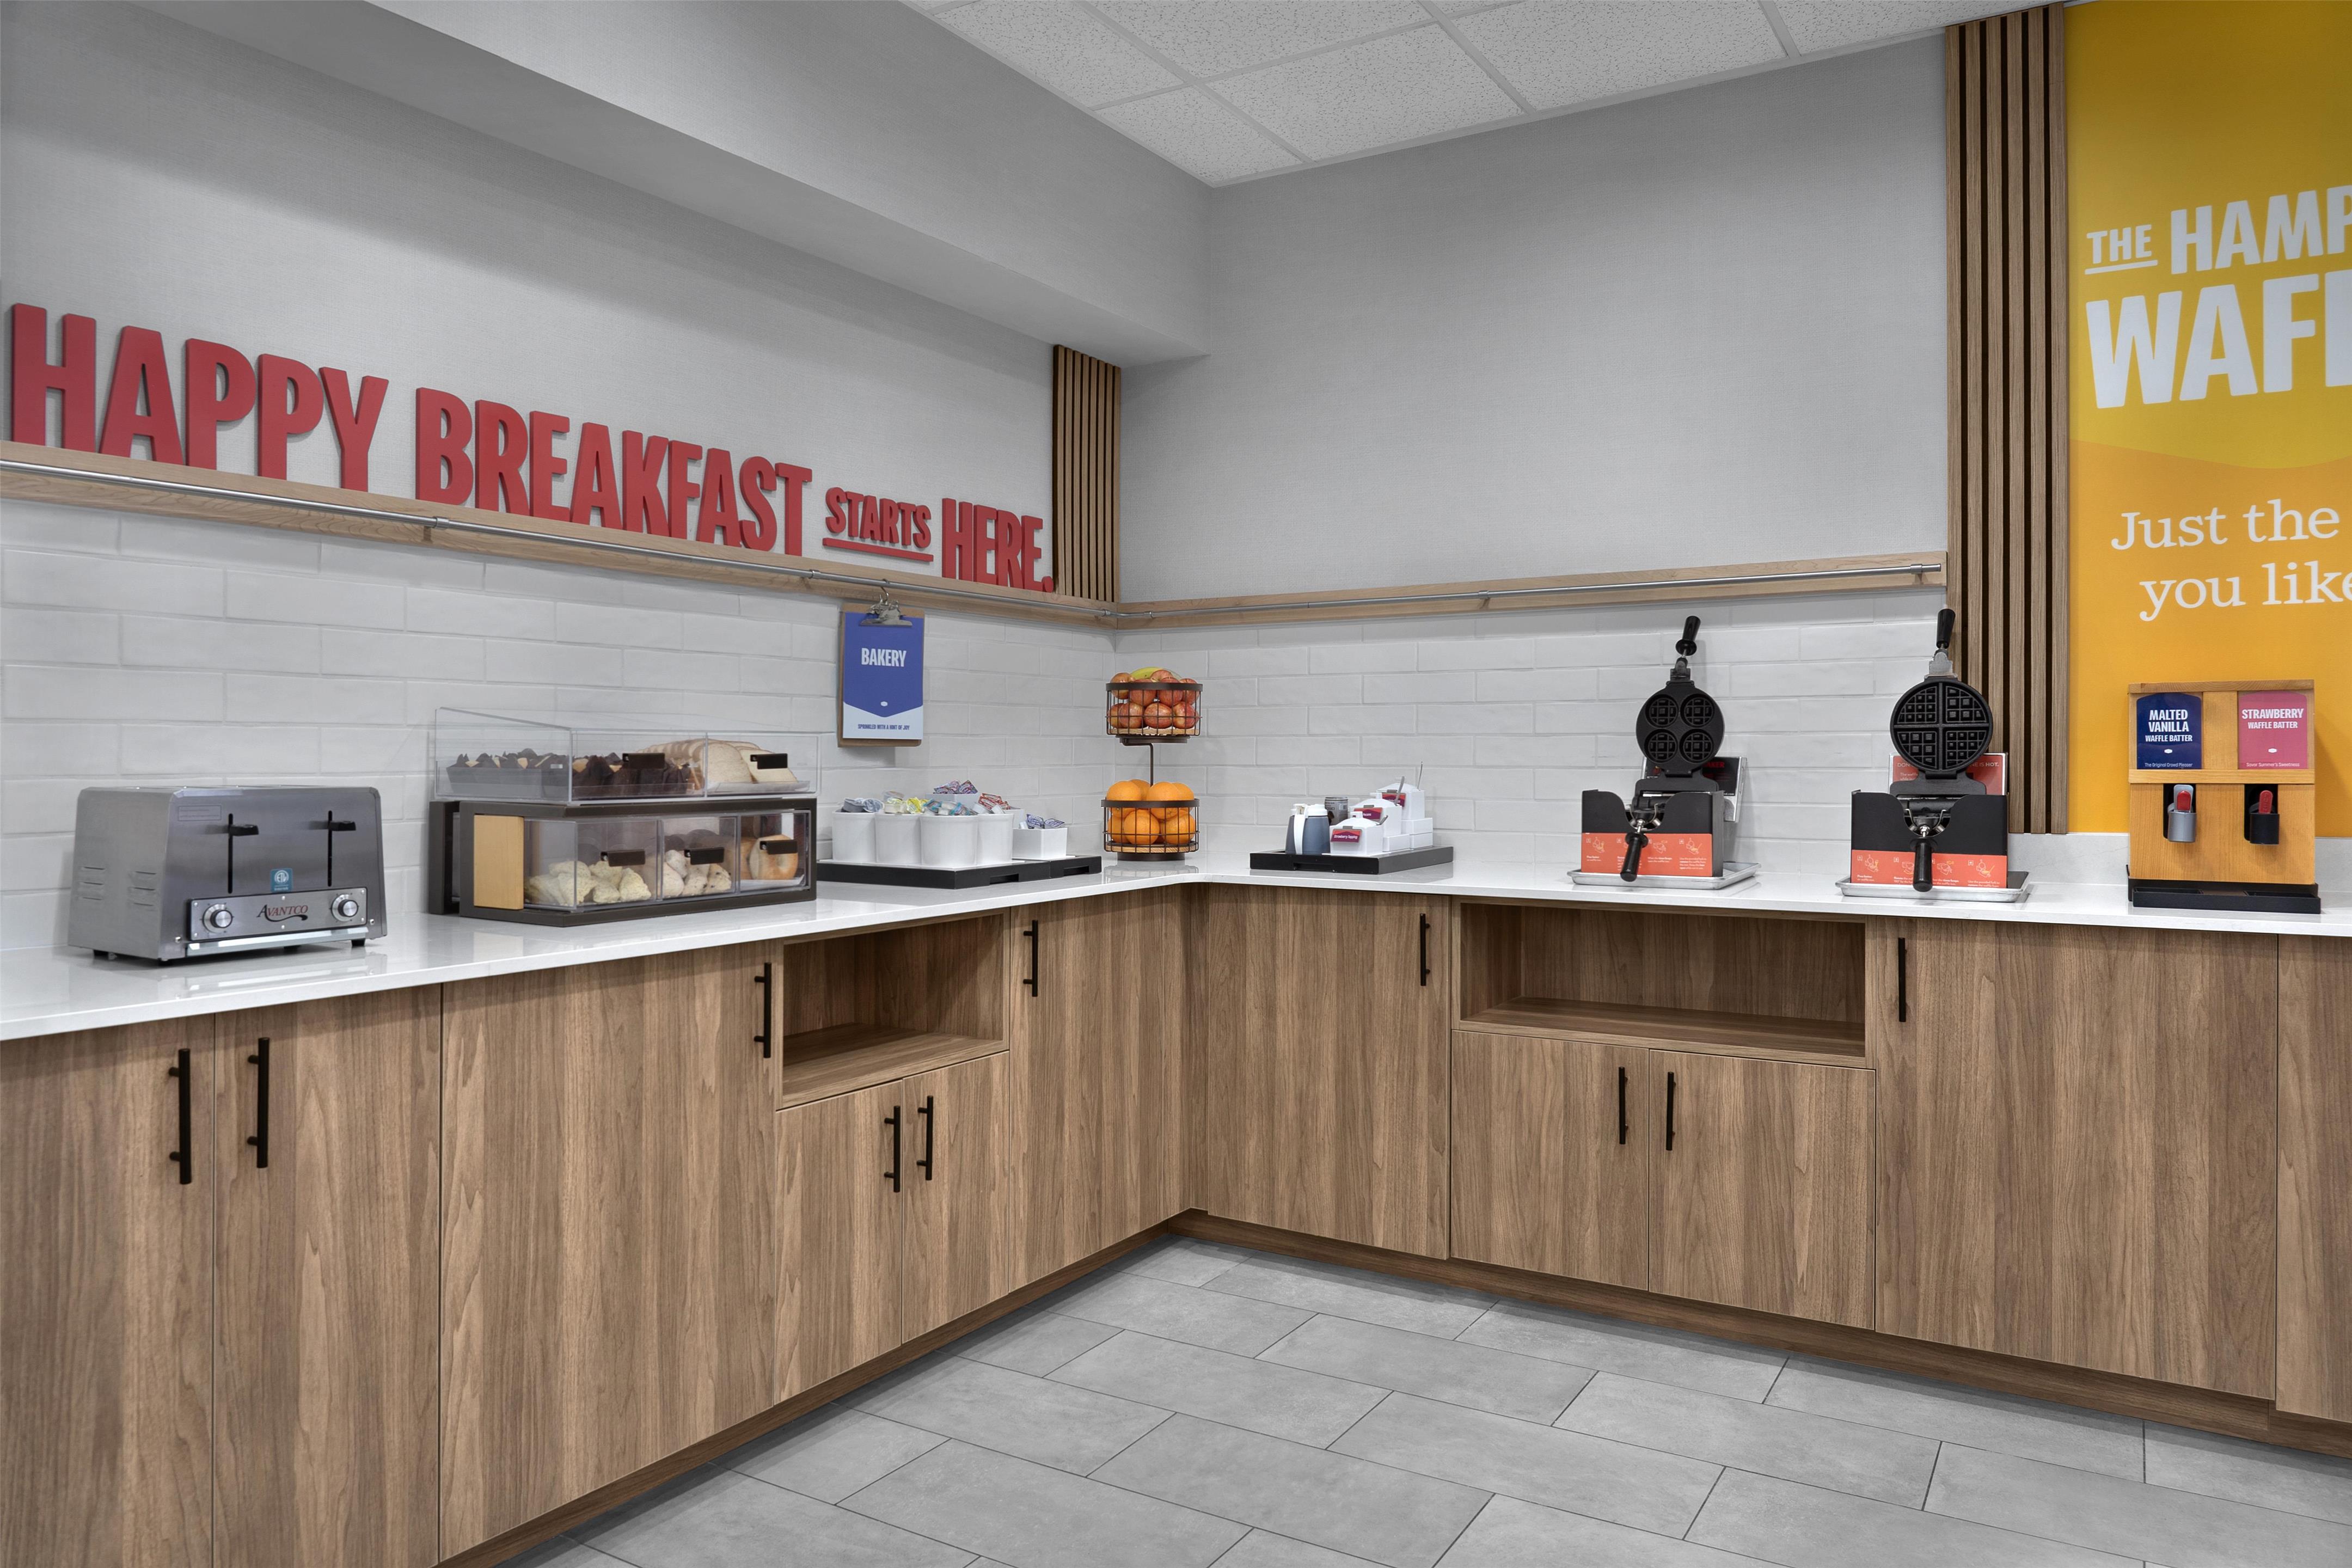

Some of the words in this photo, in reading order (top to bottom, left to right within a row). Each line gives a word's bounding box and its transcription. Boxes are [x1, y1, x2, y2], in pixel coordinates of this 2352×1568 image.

[2086, 224, 2152, 265] THE
[2171, 185, 2352, 275] HAMP
[11, 303, 389, 493] HAPPY
[415, 387, 813, 557] BREAKFAST
[825, 487, 932, 549] STARTS
[942, 498, 1054, 593] HERE.
[2111, 507, 2228, 550] Just
[2243, 499, 2340, 543] the
[2139, 576, 2246, 622] you
[861, 647, 907, 667] BAKERY
[2149, 709, 2189, 721] MALTED
[2242, 708, 2304, 719] STRAWBERRY
[2148, 721, 2190, 733] VANILLA
[256, 904, 308, 922] AVANTCO
